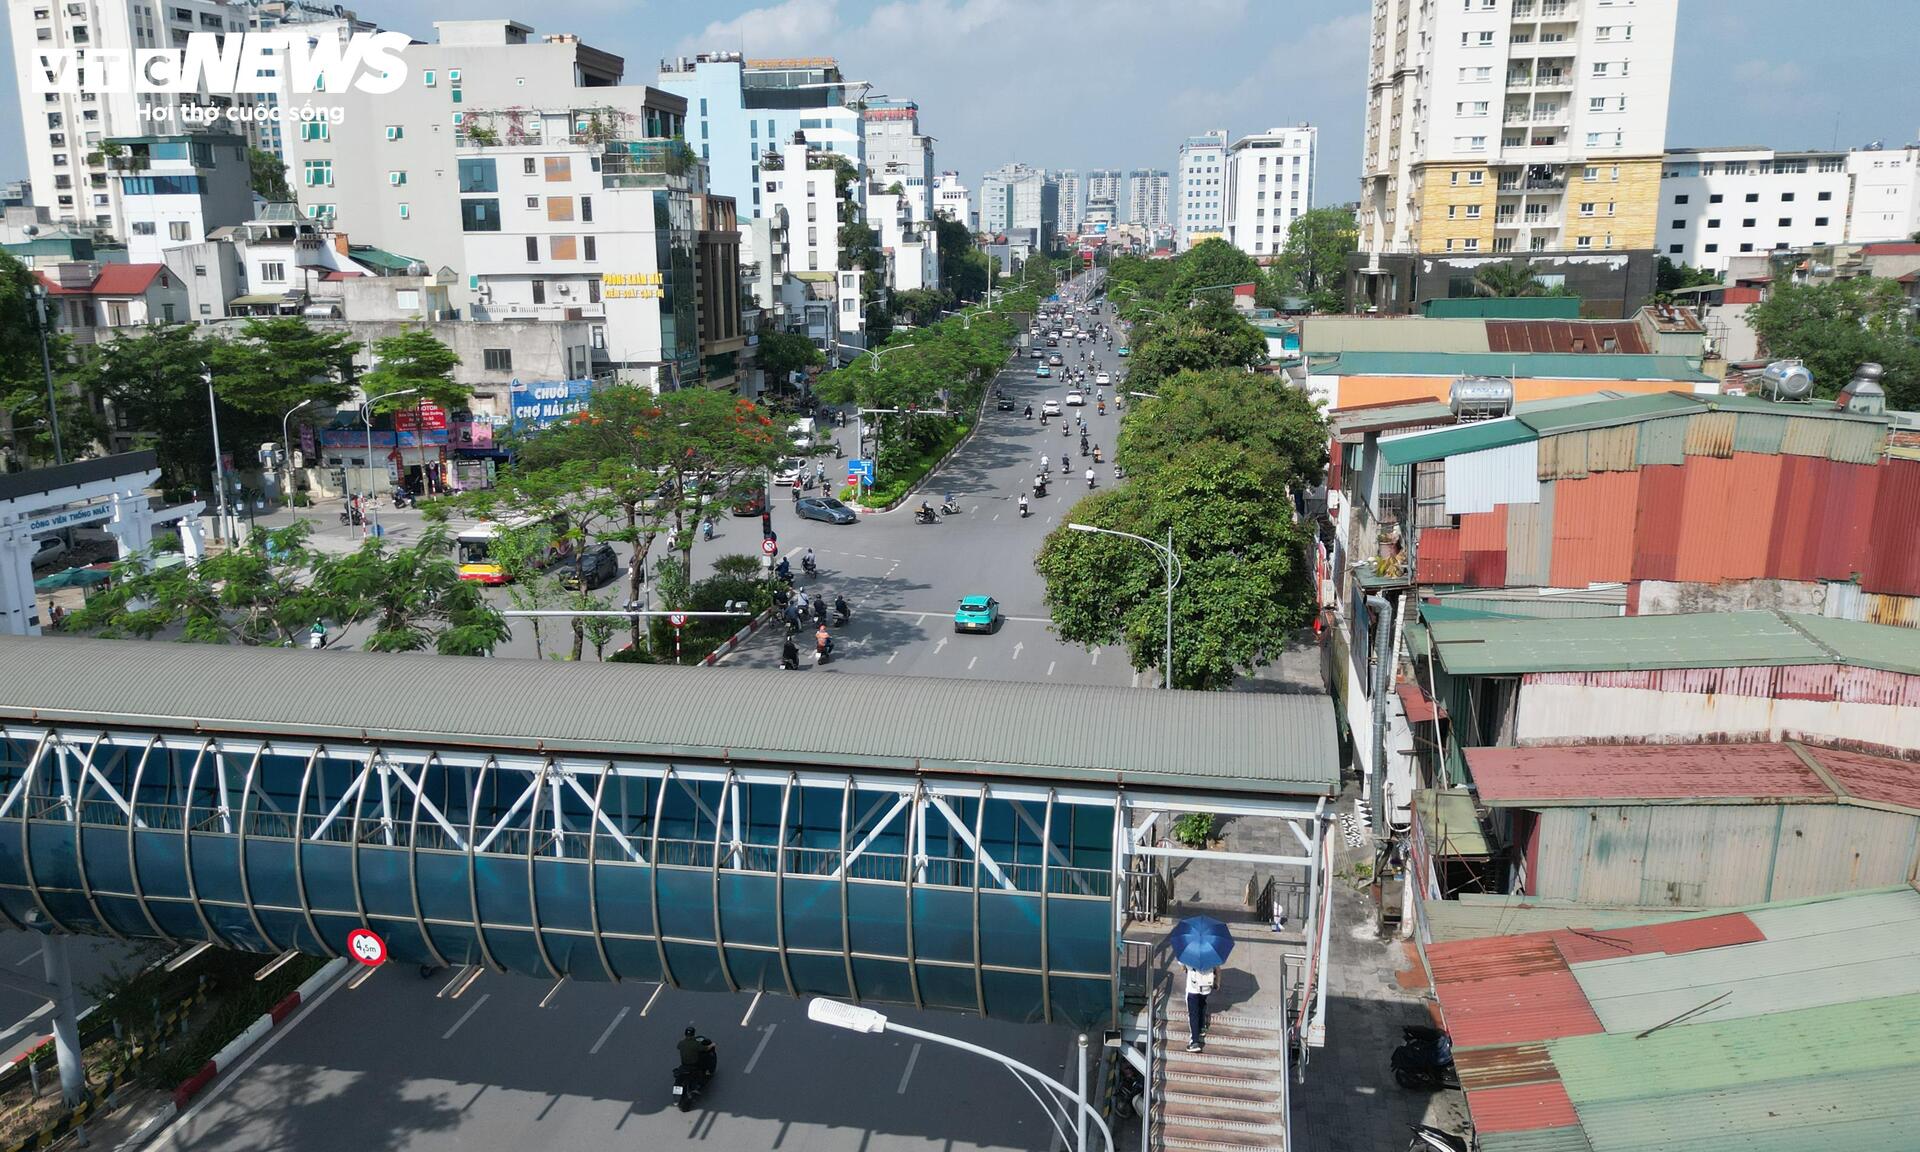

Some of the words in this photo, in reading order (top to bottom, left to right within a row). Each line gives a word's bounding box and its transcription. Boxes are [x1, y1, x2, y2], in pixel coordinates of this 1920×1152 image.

[534, 382, 569, 400] CHUỖI
[516, 402, 541, 420] CHỢ
[543, 400, 564, 417] HẢI
[30, 519, 50, 530] CÔNG
[52, 515, 67, 525] VIÊN
[69, 510, 91, 519] THỐNG
[92, 505, 110, 515] NHẤT
